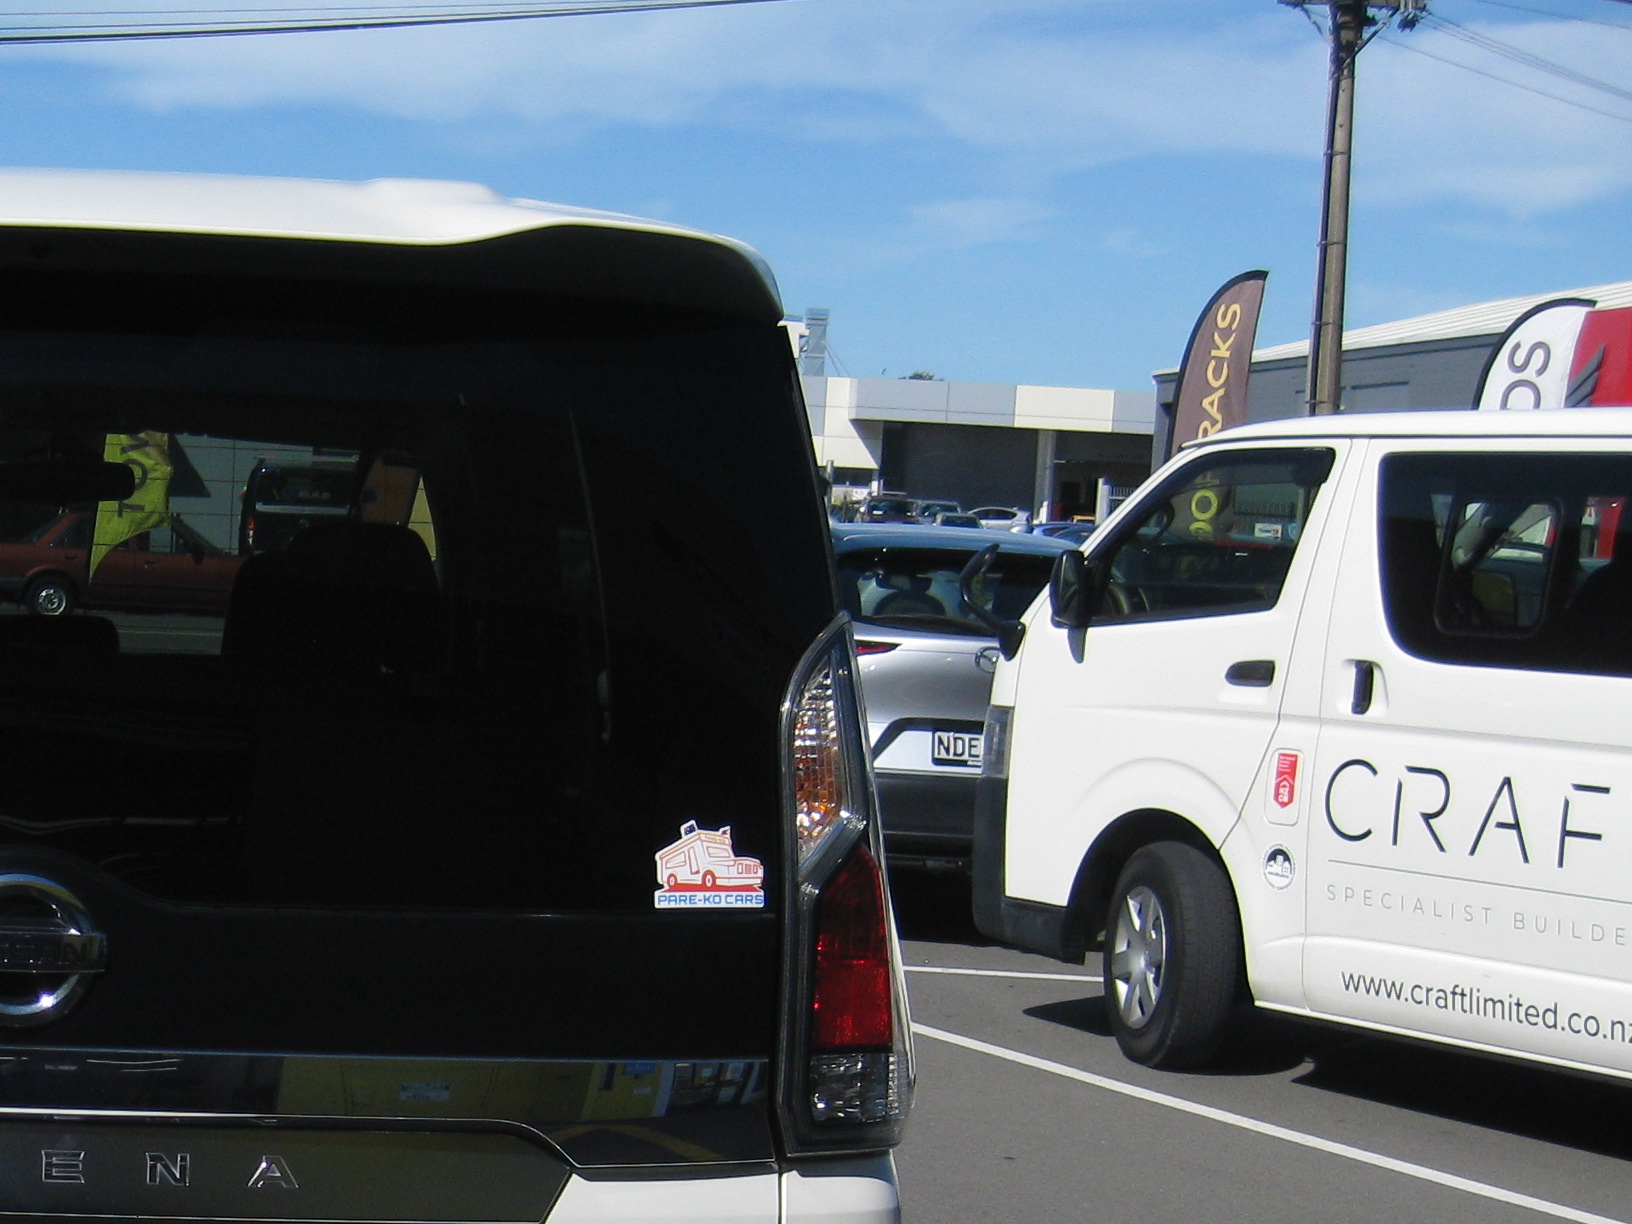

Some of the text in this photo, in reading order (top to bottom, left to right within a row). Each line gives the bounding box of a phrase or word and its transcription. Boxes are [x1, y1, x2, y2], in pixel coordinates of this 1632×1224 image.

[1197, 302, 1242, 440] RACKS
[937, 734, 980, 758] NDE
[1325, 758, 1611, 869] CRAF
[657, 893, 764, 906] PARE-KO CARS
[1326, 884, 1626, 946] SPECIALIST BUILDE
